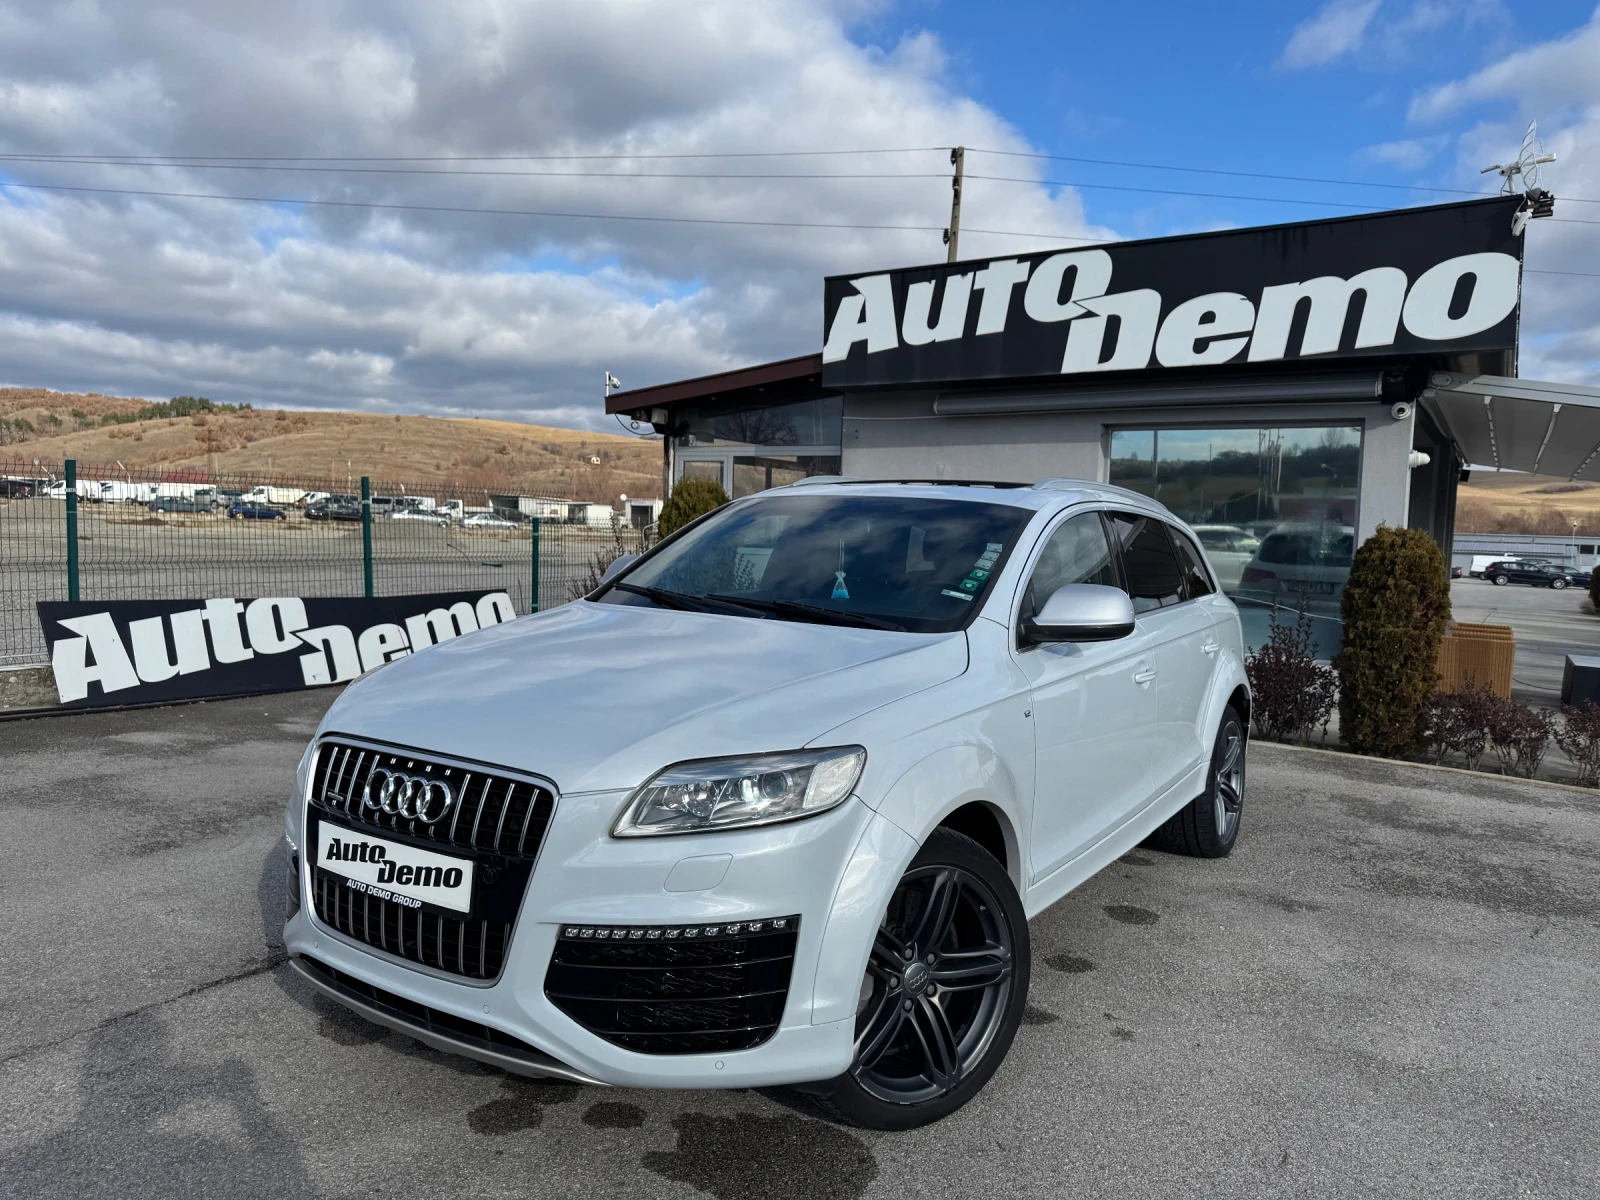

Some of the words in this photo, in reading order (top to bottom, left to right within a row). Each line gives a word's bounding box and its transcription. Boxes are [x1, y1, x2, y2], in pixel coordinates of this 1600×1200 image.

[823, 249, 1112, 363] Auto
[1061, 252, 1519, 374] Demo
[52, 597, 308, 703] Auto
[326, 838, 386, 864] Auto
[377, 860, 463, 888] Demo
[346, 879, 366, 892] AUTO
[367, 886, 391, 900] DEMO
[392, 893, 422, 909] GROUP
